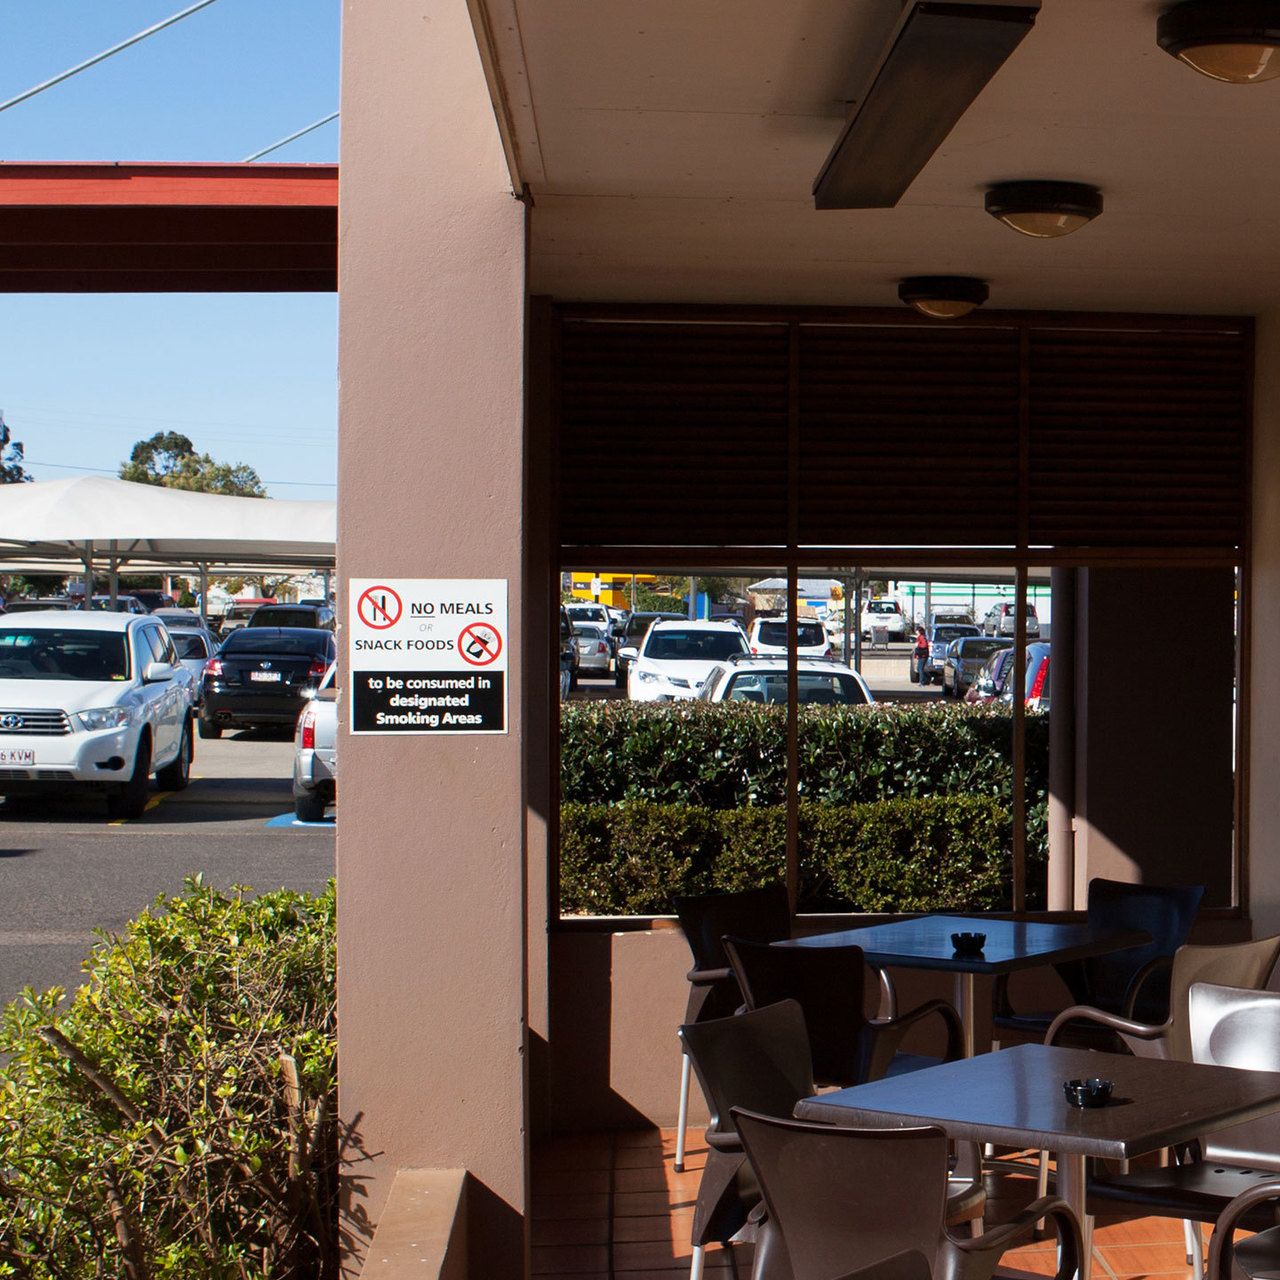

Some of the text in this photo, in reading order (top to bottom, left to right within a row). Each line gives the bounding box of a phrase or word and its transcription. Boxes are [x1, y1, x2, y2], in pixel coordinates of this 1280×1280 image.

[411, 603, 493, 615] NO MEALS
[419, 624, 433, 632] OR
[355, 639, 454, 650] SNACK FOODS
[368, 676, 491, 689] to be consumed in
[390, 694, 469, 708] designated
[376, 712, 482, 727] Smoking Areas
[10, 751, 32, 760] KVM
